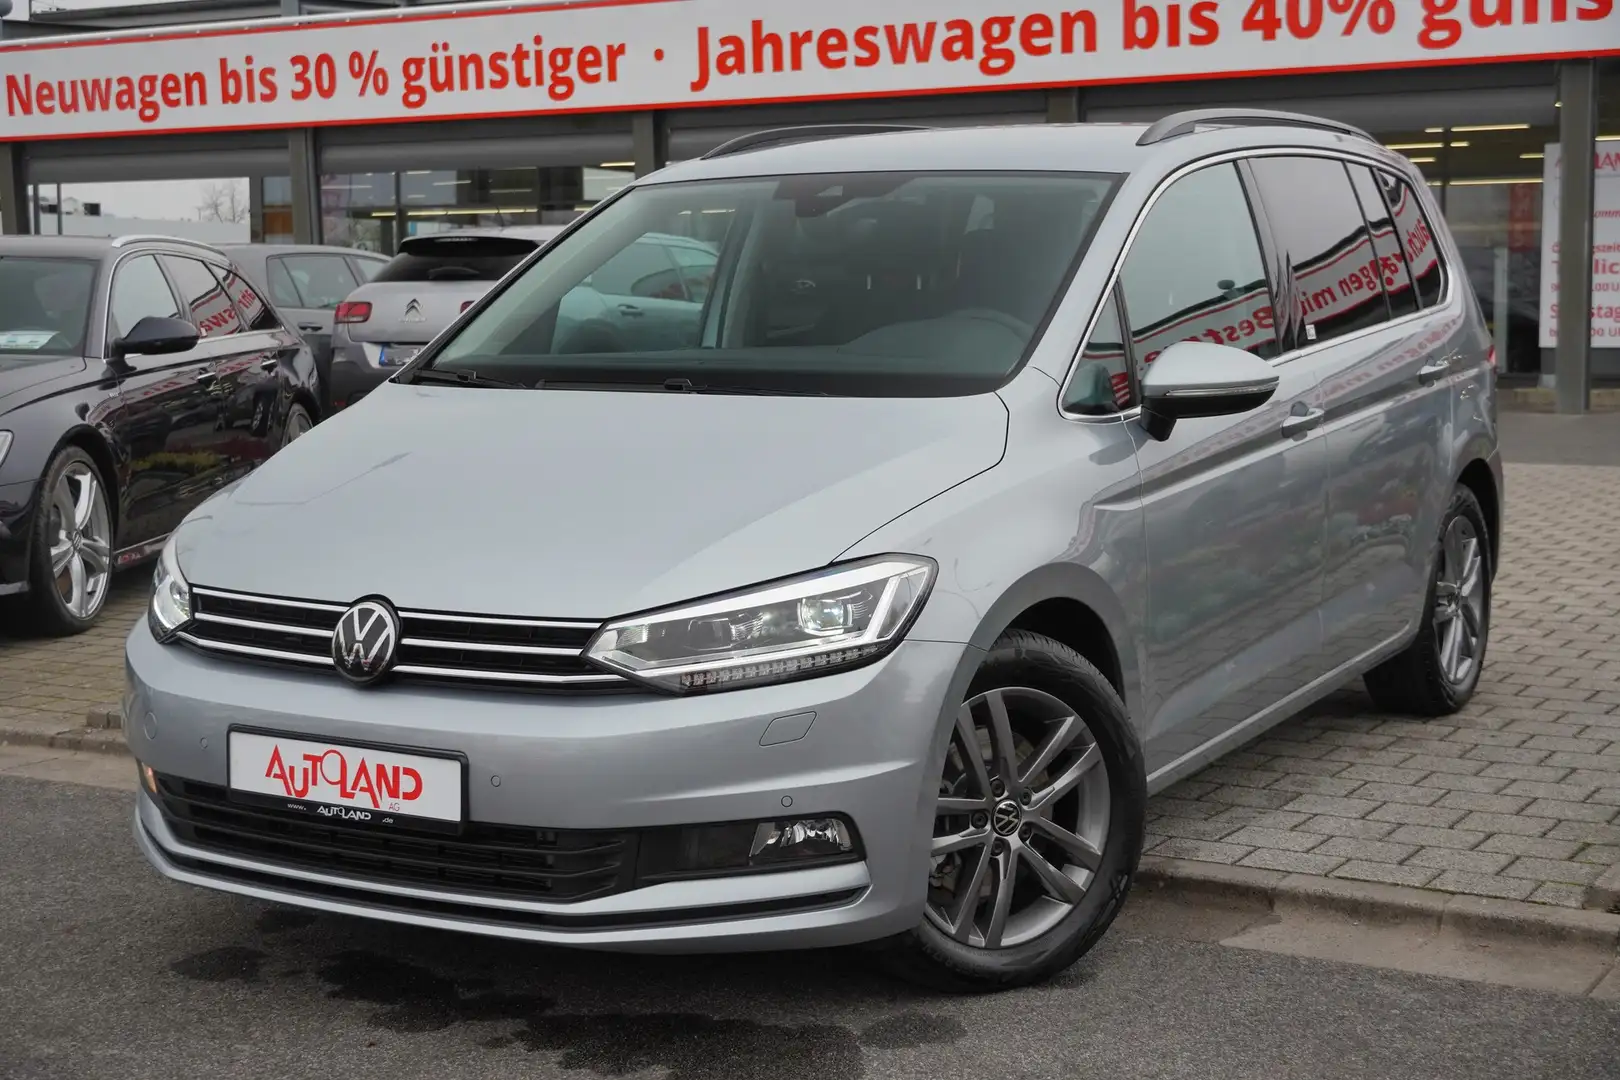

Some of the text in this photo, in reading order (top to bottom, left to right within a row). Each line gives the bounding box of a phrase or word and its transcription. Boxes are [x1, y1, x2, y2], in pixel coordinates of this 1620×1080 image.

[5, 71, 207, 122] Neuwagen
[219, 55, 278, 105] bis
[290, 53, 337, 101] 30
[348, 49, 389, 96] %
[401, 34, 627, 110] günstiger
[689, 9, 1097, 93] Jahreswagen
[1122, 0, 1220, 51] bis
[1241, 0, 1397, 41] 40%
[265, 744, 423, 809] AUTOLAND
[317, 805, 372, 820] AUTOLAND
[388, 802, 401, 812] AG
